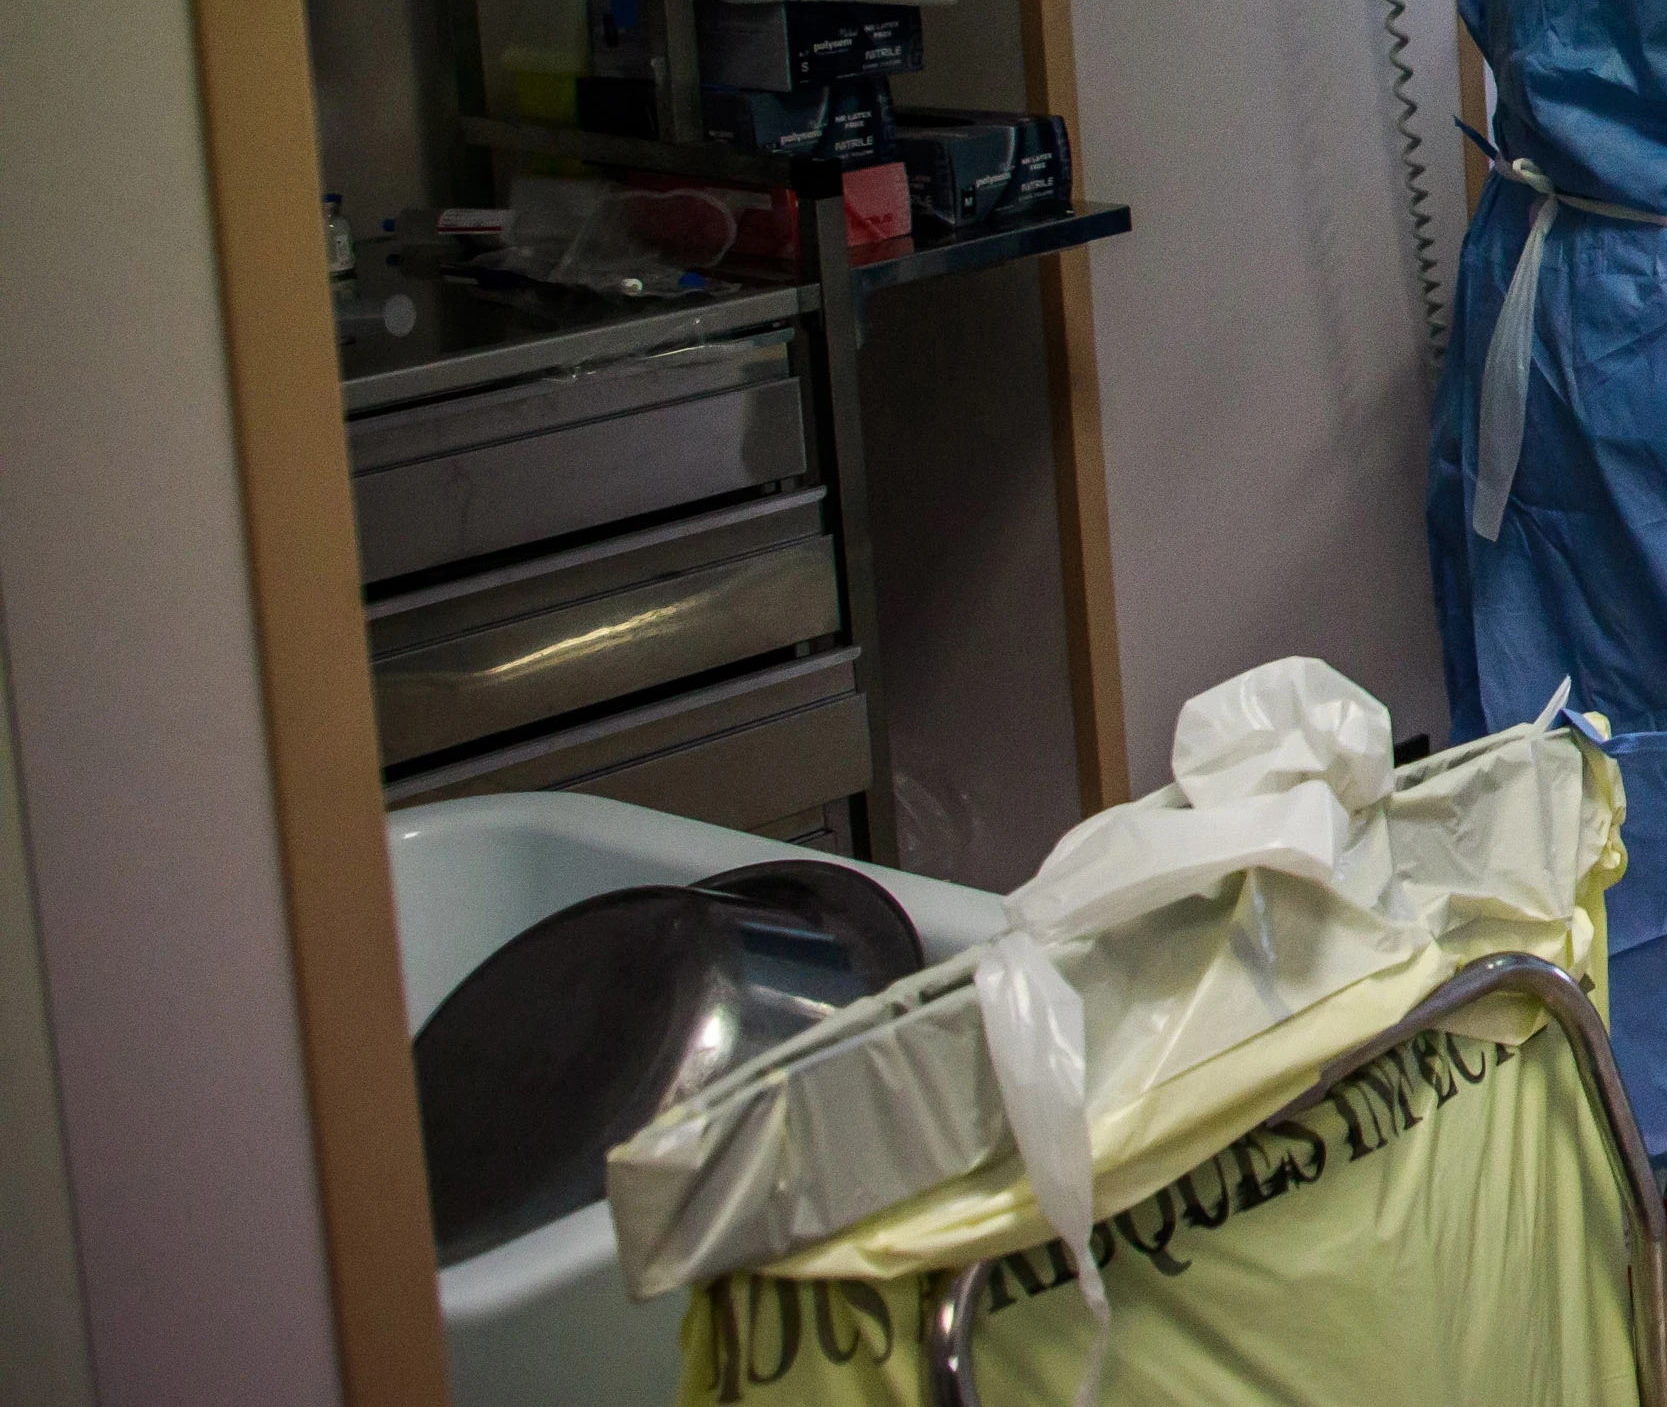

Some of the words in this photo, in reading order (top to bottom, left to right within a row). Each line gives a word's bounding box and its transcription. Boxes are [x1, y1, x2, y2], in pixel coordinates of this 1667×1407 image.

[864, 45, 902, 60] NITRILE
[800, 61, 810, 73] S
[834, 135, 875, 151] NITRILE
